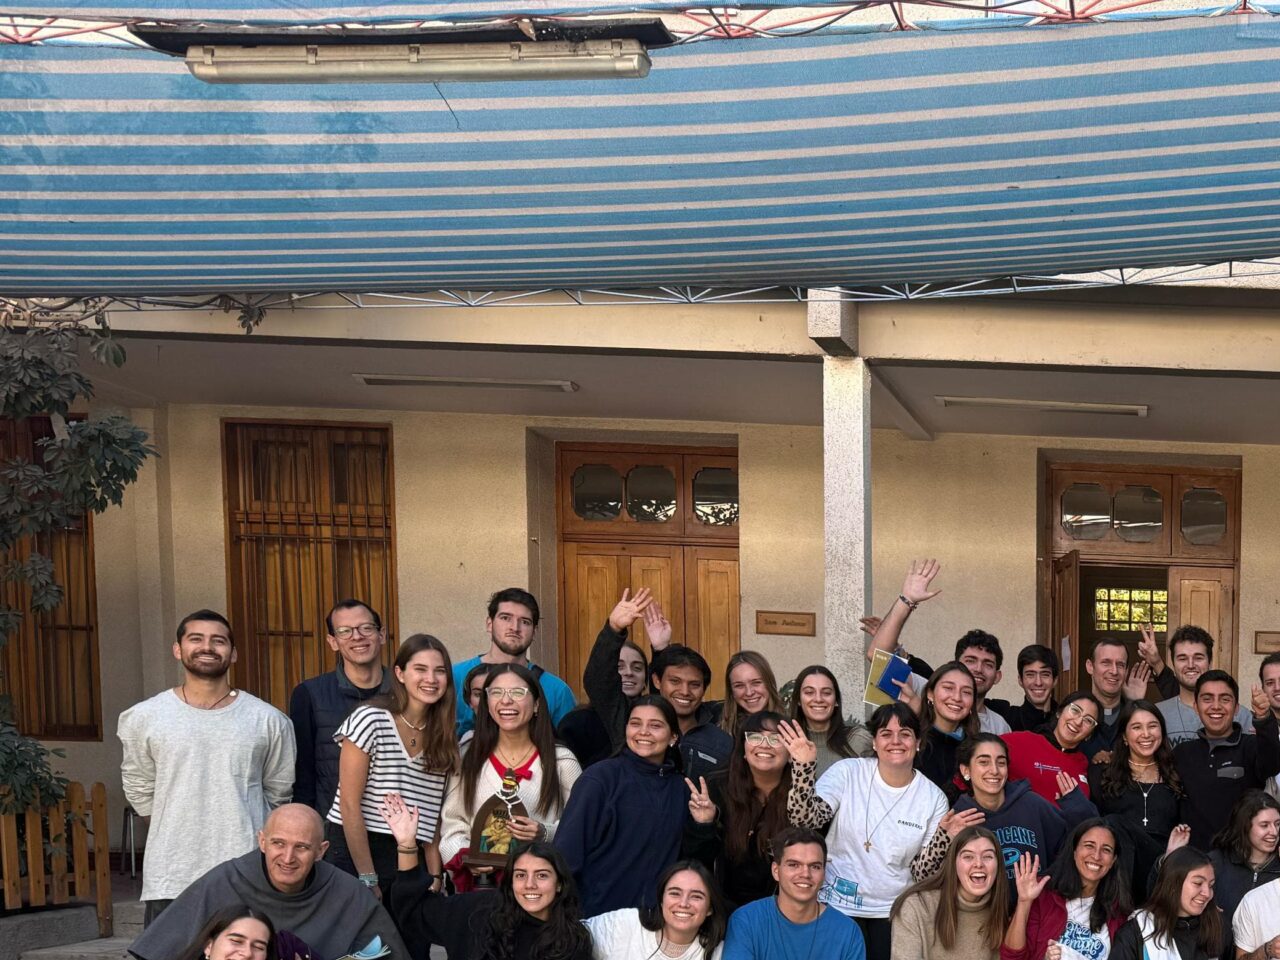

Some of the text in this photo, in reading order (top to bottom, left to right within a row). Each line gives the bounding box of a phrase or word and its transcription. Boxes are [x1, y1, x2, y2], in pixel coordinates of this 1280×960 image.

[897, 819, 923, 830] BANDERAS
[995, 826, 1038, 848] ICANE
[1060, 936, 1103, 955] iempre
